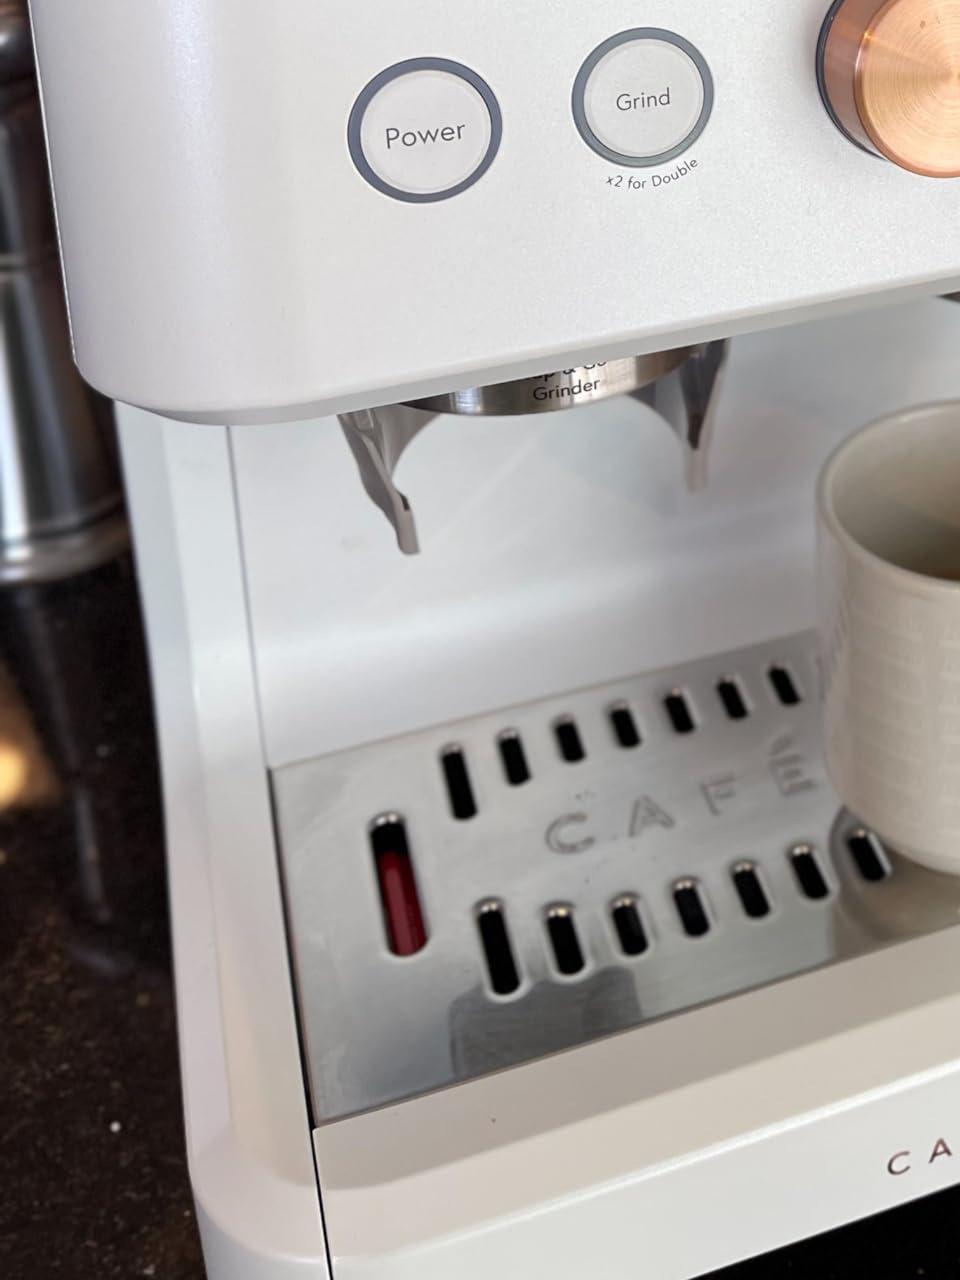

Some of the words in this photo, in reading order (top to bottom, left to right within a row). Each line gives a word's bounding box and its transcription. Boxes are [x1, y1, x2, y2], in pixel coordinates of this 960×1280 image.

[615, 87, 671, 112] Grind
[385, 123, 466, 150] Power
[627, 175, 647, 190] for
[651, 159, 698, 187] Double
[533, 379, 601, 401] Grinder
[544, 729, 817, 855] CAFÉ
